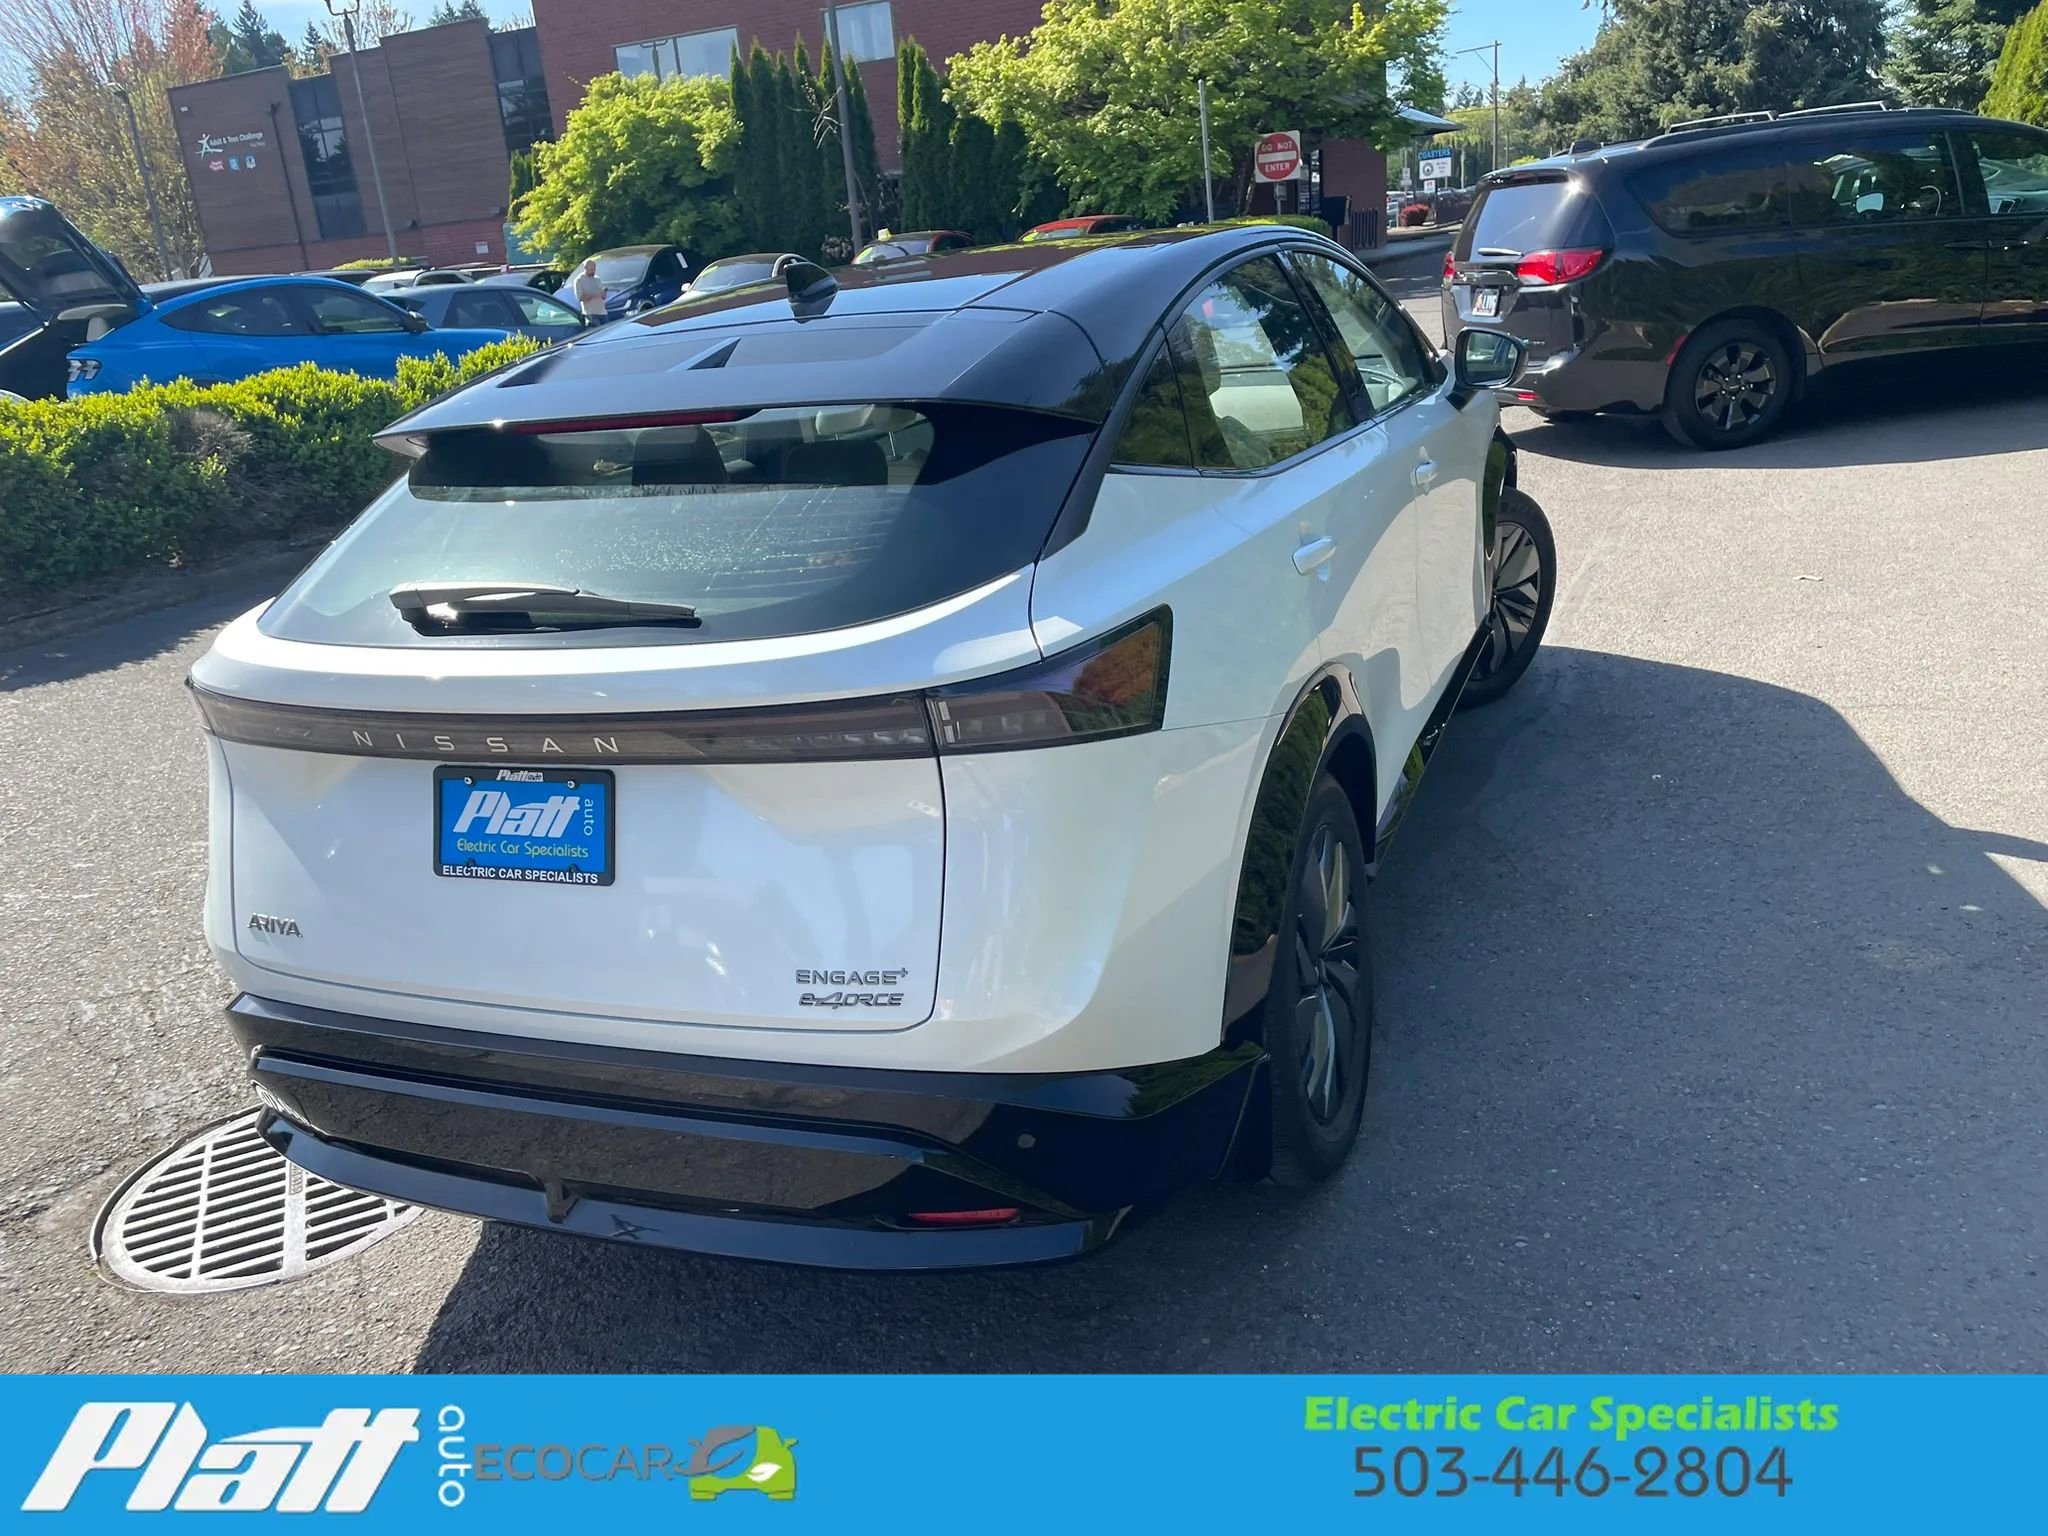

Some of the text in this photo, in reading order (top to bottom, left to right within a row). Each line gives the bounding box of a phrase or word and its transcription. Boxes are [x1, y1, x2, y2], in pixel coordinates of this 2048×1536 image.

[1261, 141, 1293, 152] DO NOT
[1418, 148, 1451, 160] COASTERS
[1265, 162, 1290, 172] ENTER
[352, 730, 619, 753] NISSAN
[496, 769, 528, 782] Platt
[452, 790, 580, 839] Platt
[583, 798, 594, 836] auto
[457, 838, 589, 859] Electric Car Specialists
[442, 865, 598, 884] ELECTRIC CAR SPECIALISTS
[246, 911, 303, 938] ARIYA
